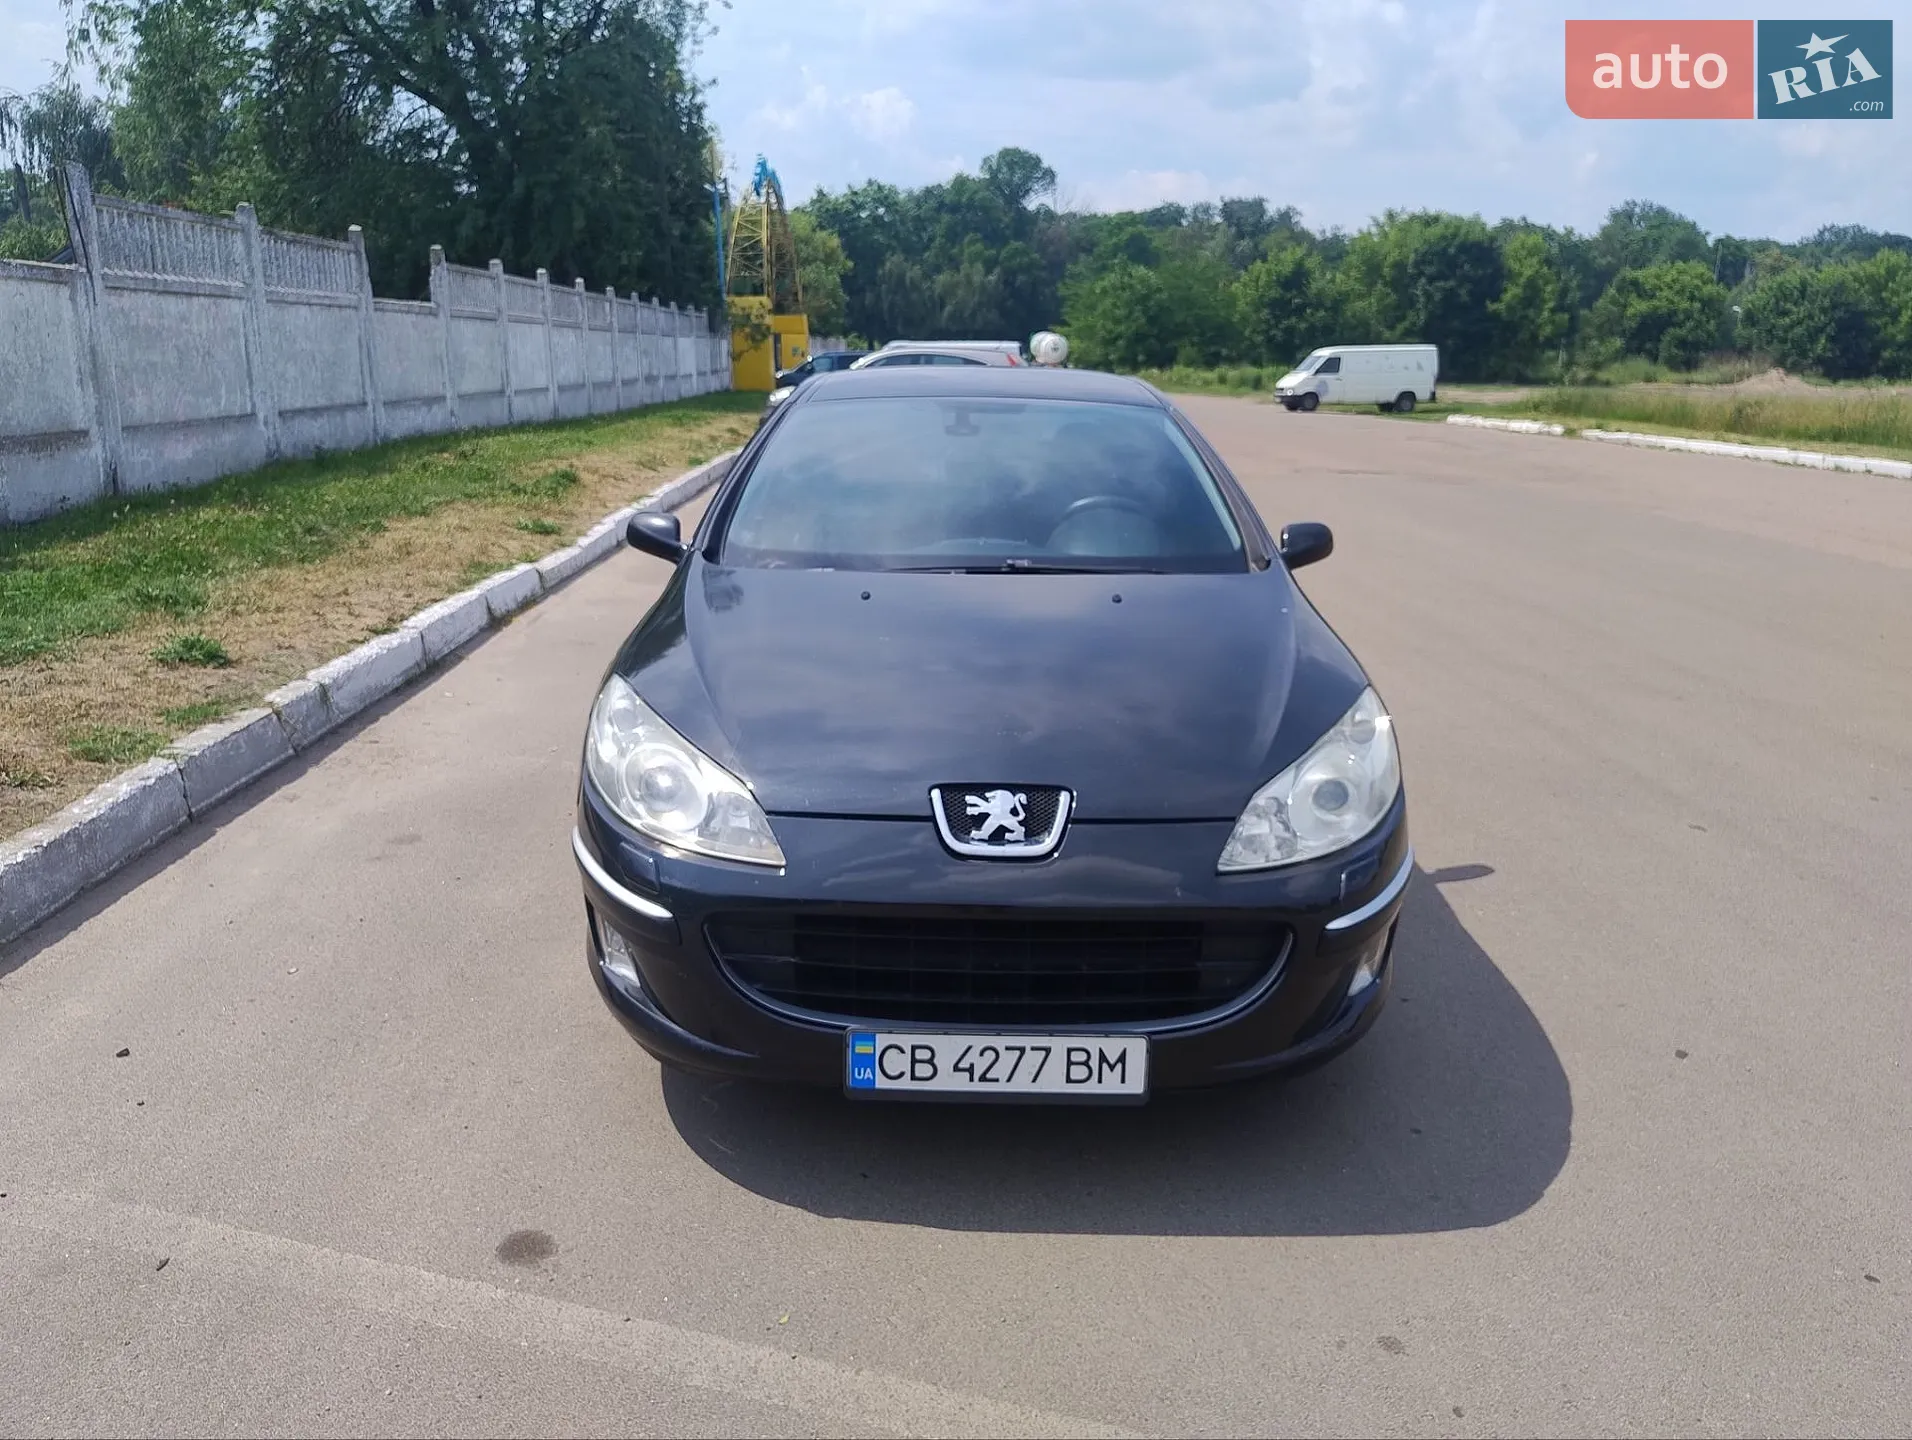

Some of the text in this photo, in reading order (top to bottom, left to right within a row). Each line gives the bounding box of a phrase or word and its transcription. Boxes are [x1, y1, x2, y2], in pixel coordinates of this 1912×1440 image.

[854, 1067, 874, 1081] UA
[878, 1043, 1127, 1084] CB 4277 BM
